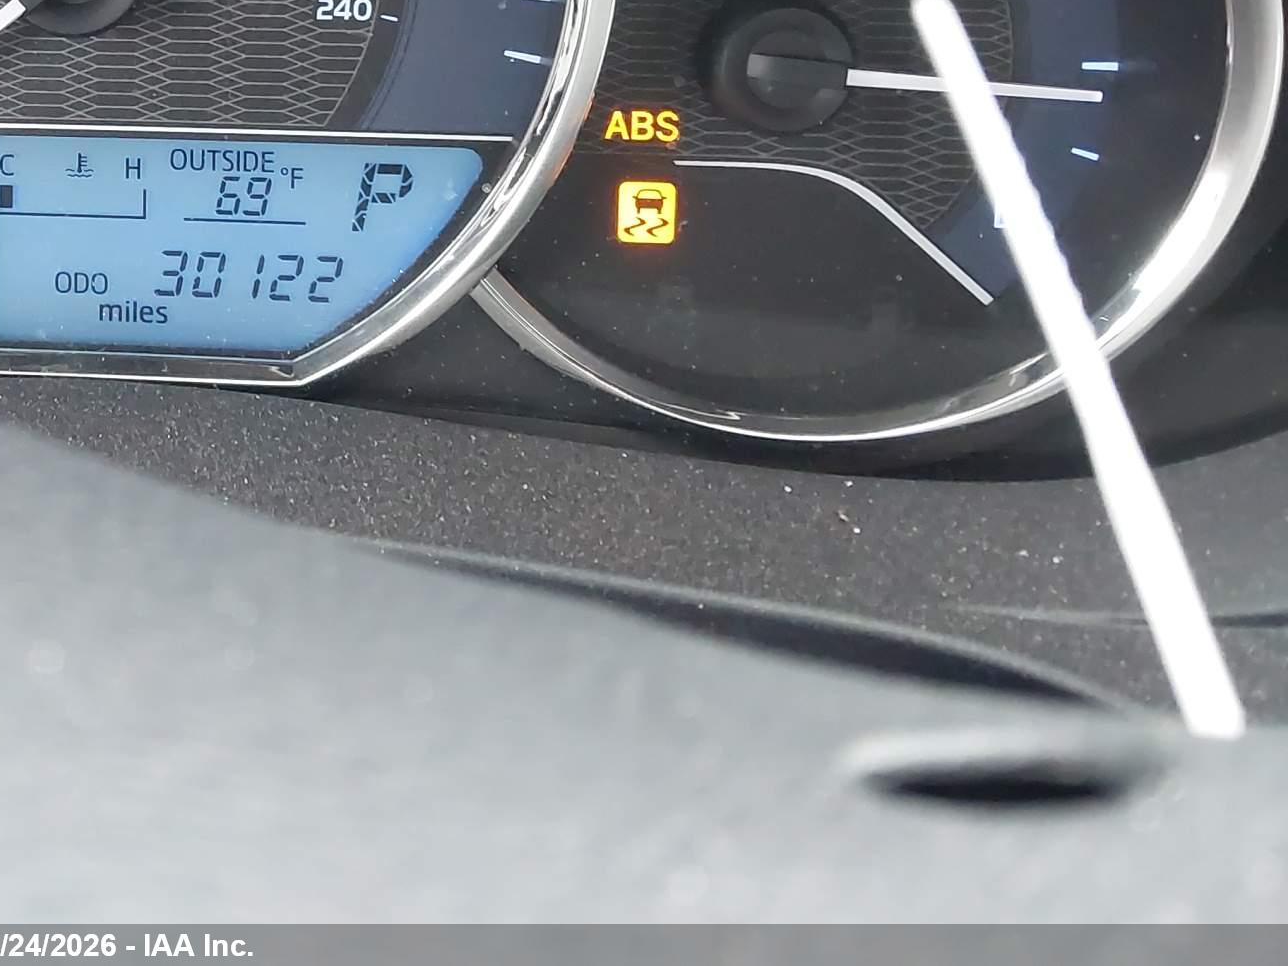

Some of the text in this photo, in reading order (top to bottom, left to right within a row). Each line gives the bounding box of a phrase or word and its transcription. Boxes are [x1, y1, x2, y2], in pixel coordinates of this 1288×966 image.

[605, 111, 680, 142] ABS
[0, 154, 14, 176] C
[125, 158, 141, 180] H
[170, 148, 275, 173] OUTSIDE
[352, 163, 413, 232] P
[55, 250, 344, 303] ODO 30122
[98, 301, 169, 324] miles
